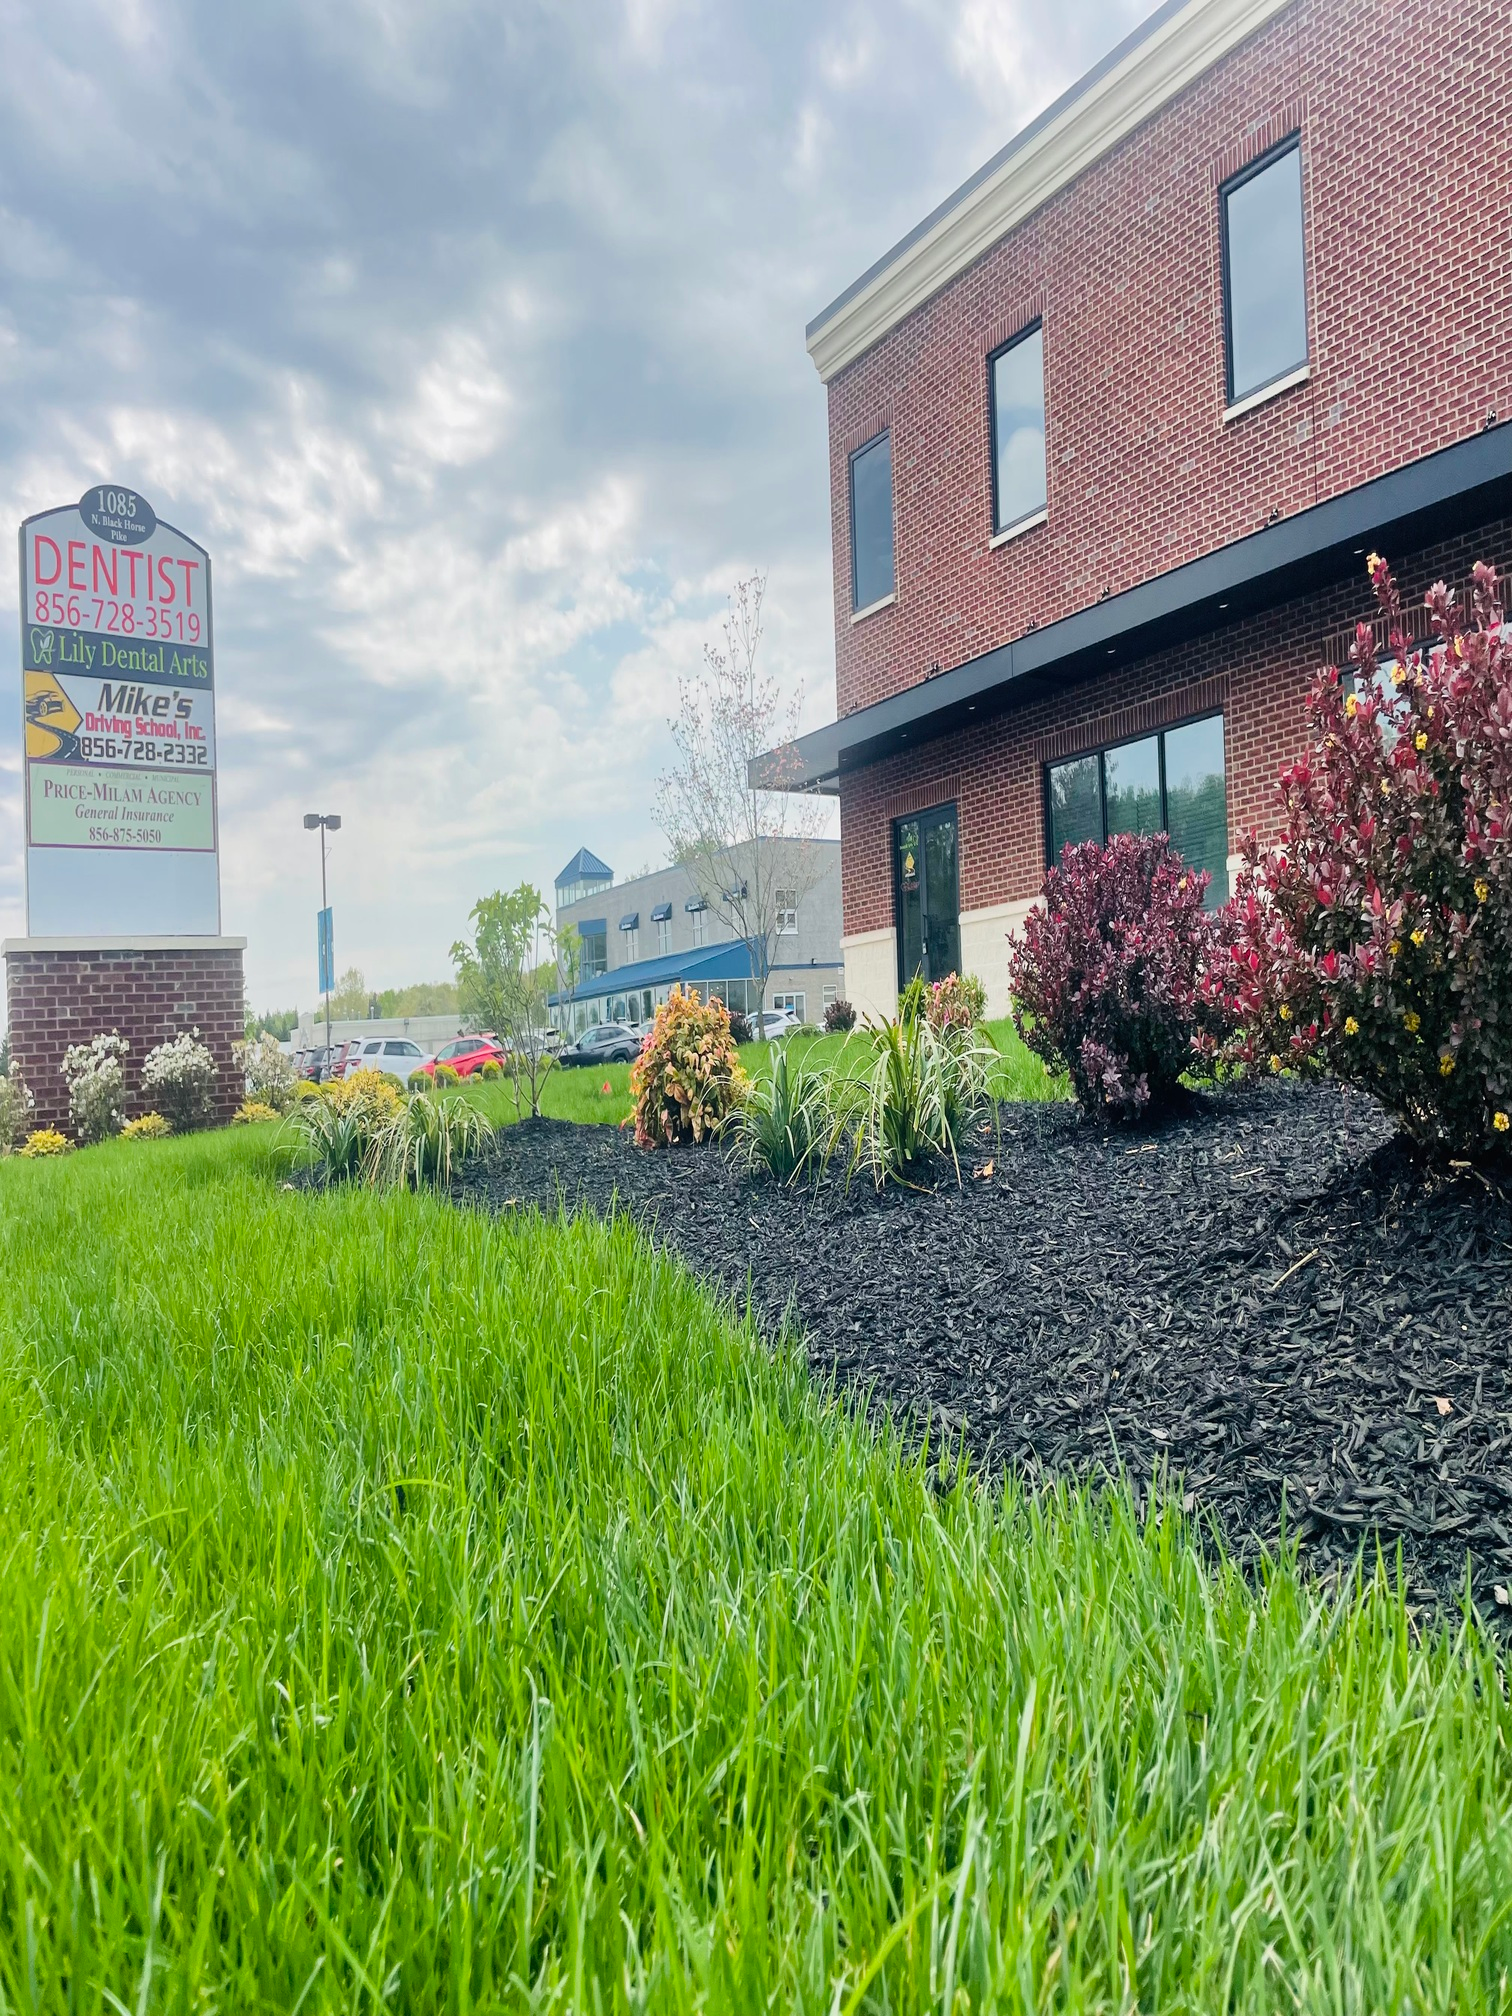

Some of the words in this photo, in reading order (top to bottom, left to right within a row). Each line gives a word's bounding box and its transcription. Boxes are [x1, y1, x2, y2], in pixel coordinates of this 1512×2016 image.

[98, 490, 136, 517] 1085
[91, 514, 101, 525] N.
[102, 516, 123, 529] Black
[124, 520, 146, 533] Horse
[111, 530, 127, 542] Pike
[34, 535, 199, 607] DENTIST
[35, 591, 200, 643] 856-728-3519
[59, 631, 96, 669] Lily
[101, 641, 164, 673] Dental
[169, 651, 207, 679] Arts
[97, 683, 193, 719] Mike's
[85, 712, 132, 739] Driving
[135, 716, 181, 740] School,
[185, 721, 206, 741] Inc.
[81, 737, 208, 765] 856-728-2332
[66, 769, 94, 778] PERSONAL
[105, 771, 141, 780] COMMERCIAL
[152, 774, 180, 783] MUNICIPAL
[44, 779, 142, 804] PRICE-MILAM
[147, 786, 202, 807] AGENCY
[75, 803, 118, 821] General
[121, 806, 175, 823] Insurance
[89, 826, 162, 843] 856-875-5050
